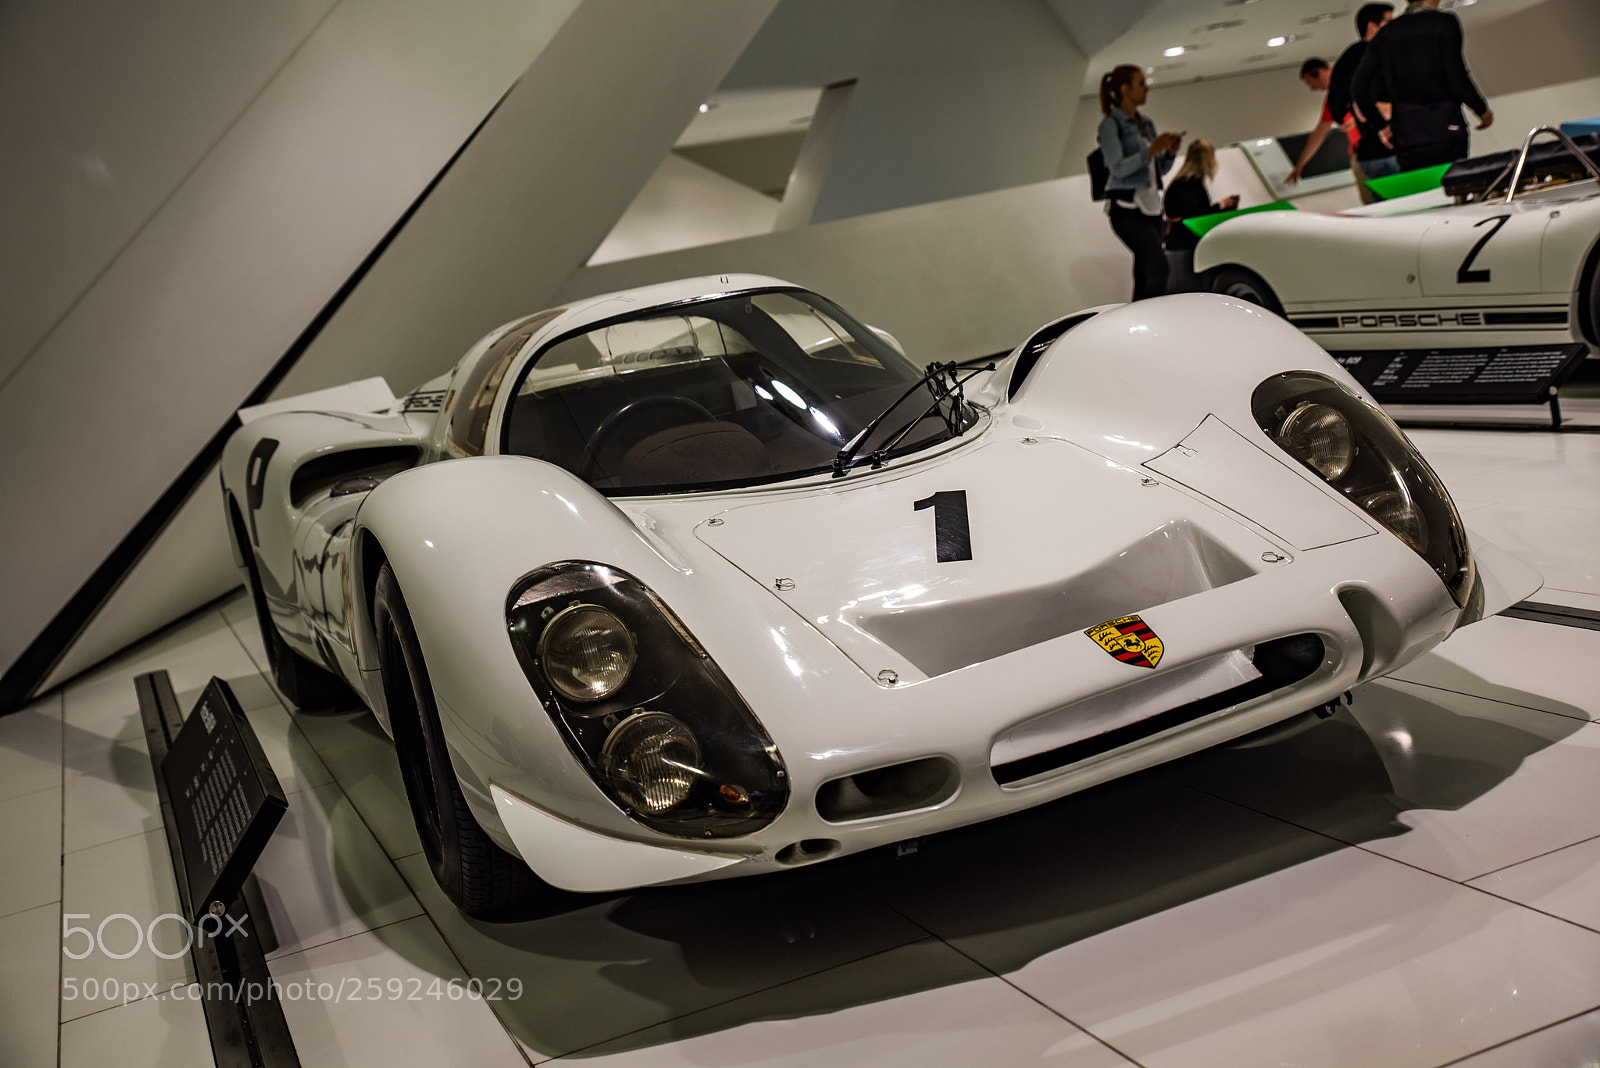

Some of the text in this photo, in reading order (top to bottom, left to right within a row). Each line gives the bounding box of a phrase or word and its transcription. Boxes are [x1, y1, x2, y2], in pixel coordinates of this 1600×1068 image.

[1457, 214, 1512, 284] 2
[1341, 313, 1482, 328] PORSCHE
[913, 490, 973, 563] 1
[1085, 615, 1140, 637] PORSCHE
